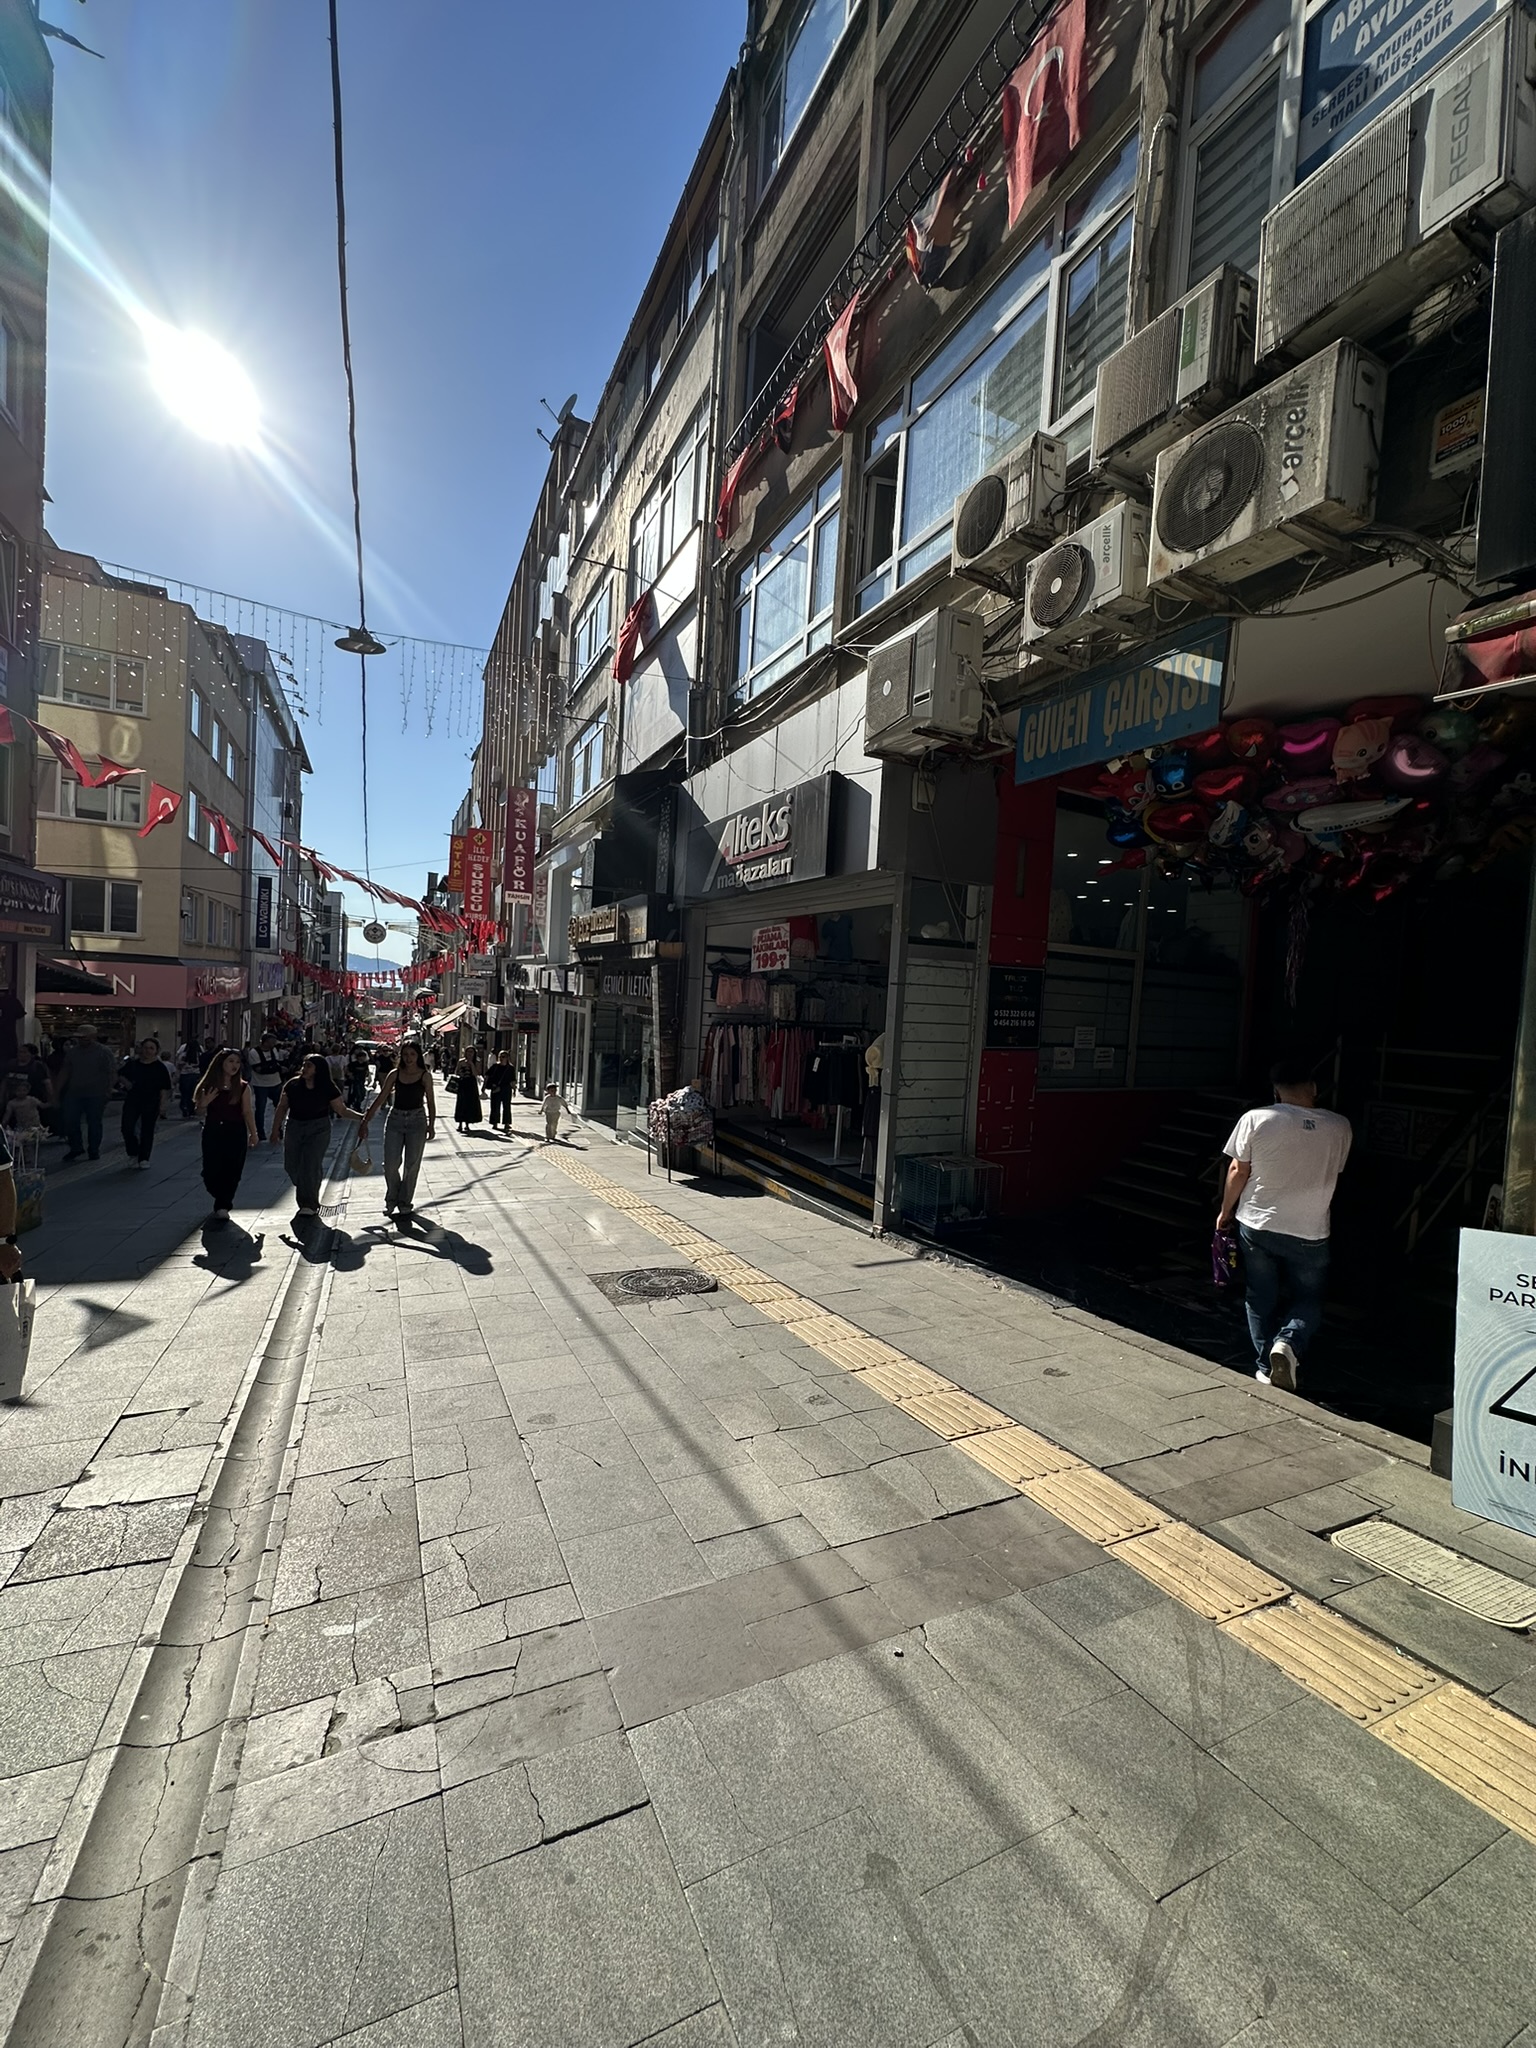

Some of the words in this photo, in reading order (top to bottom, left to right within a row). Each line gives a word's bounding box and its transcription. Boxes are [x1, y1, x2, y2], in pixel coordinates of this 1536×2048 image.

[1311, 64, 1370, 128] SERBEST
[1103, 523, 1112, 564] arçelik
[1103, 642, 1216, 748] ÇARŞISI
[453, 851, 462, 878] TKP
[512, 818, 528, 891] KUAFÖR
[469, 863, 485, 912] SÜRÜCÜ
[999, 1009, 1009, 1017] 532
[999, 1019, 1009, 1027] 454
